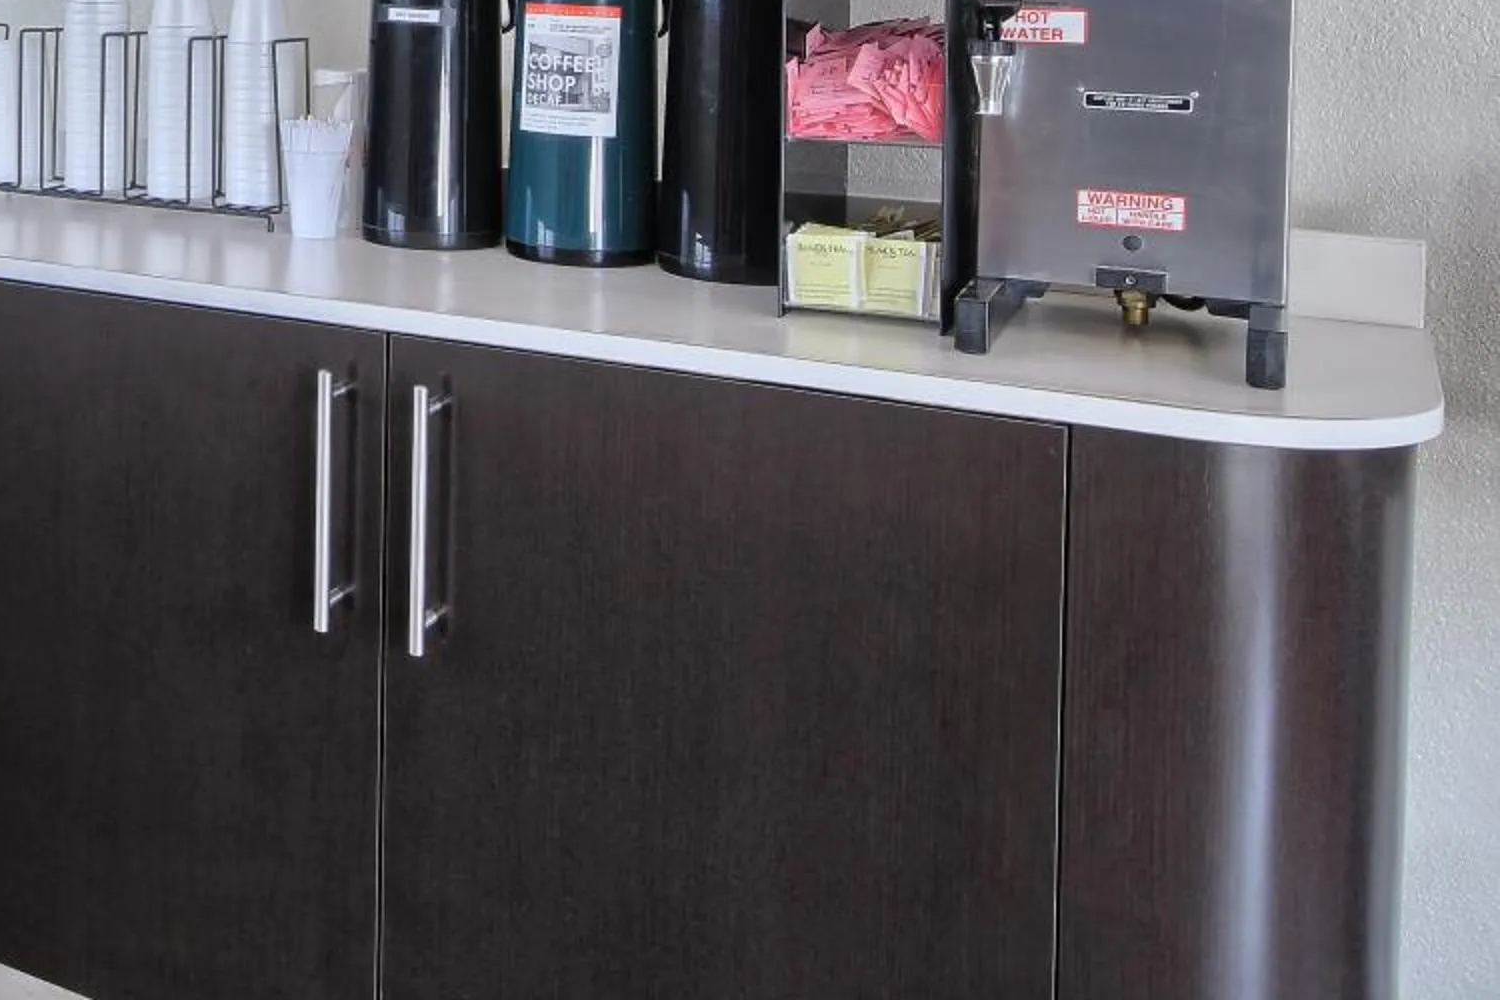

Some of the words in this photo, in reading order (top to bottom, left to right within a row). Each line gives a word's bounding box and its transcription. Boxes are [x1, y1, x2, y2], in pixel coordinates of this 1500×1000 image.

[1015, 11, 1048, 24] HOT
[998, 27, 1063, 41] WATER
[529, 53, 595, 73] COFFEE
[527, 72, 576, 92] SHOP
[1087, 191, 1173, 211] WARNING
